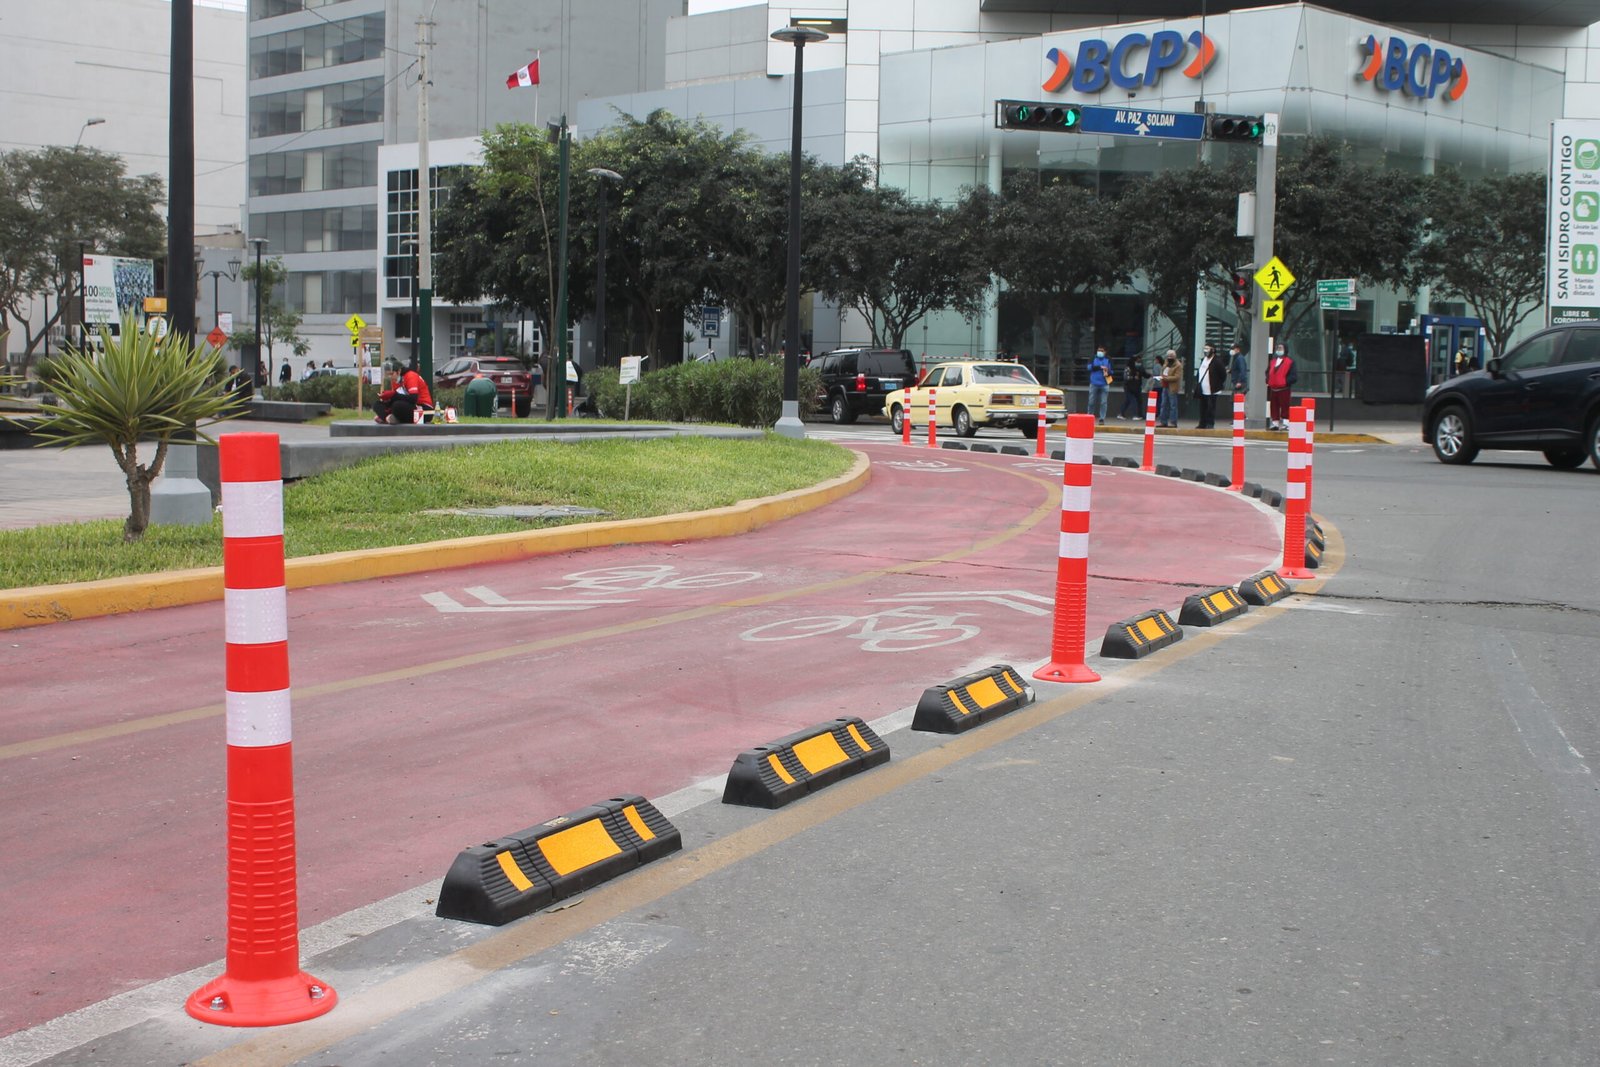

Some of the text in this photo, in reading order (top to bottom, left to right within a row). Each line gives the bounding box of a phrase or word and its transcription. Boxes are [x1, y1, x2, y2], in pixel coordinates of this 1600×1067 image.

[1072, 30, 1185, 93] BCP
[1383, 37, 1452, 99] BCP
[1115, 110, 1175, 127] AV. PAZ SOLDAN
[1557, 135, 1572, 299] SAN ISIDRO CONTIGO
[84, 285, 98, 297] 100
